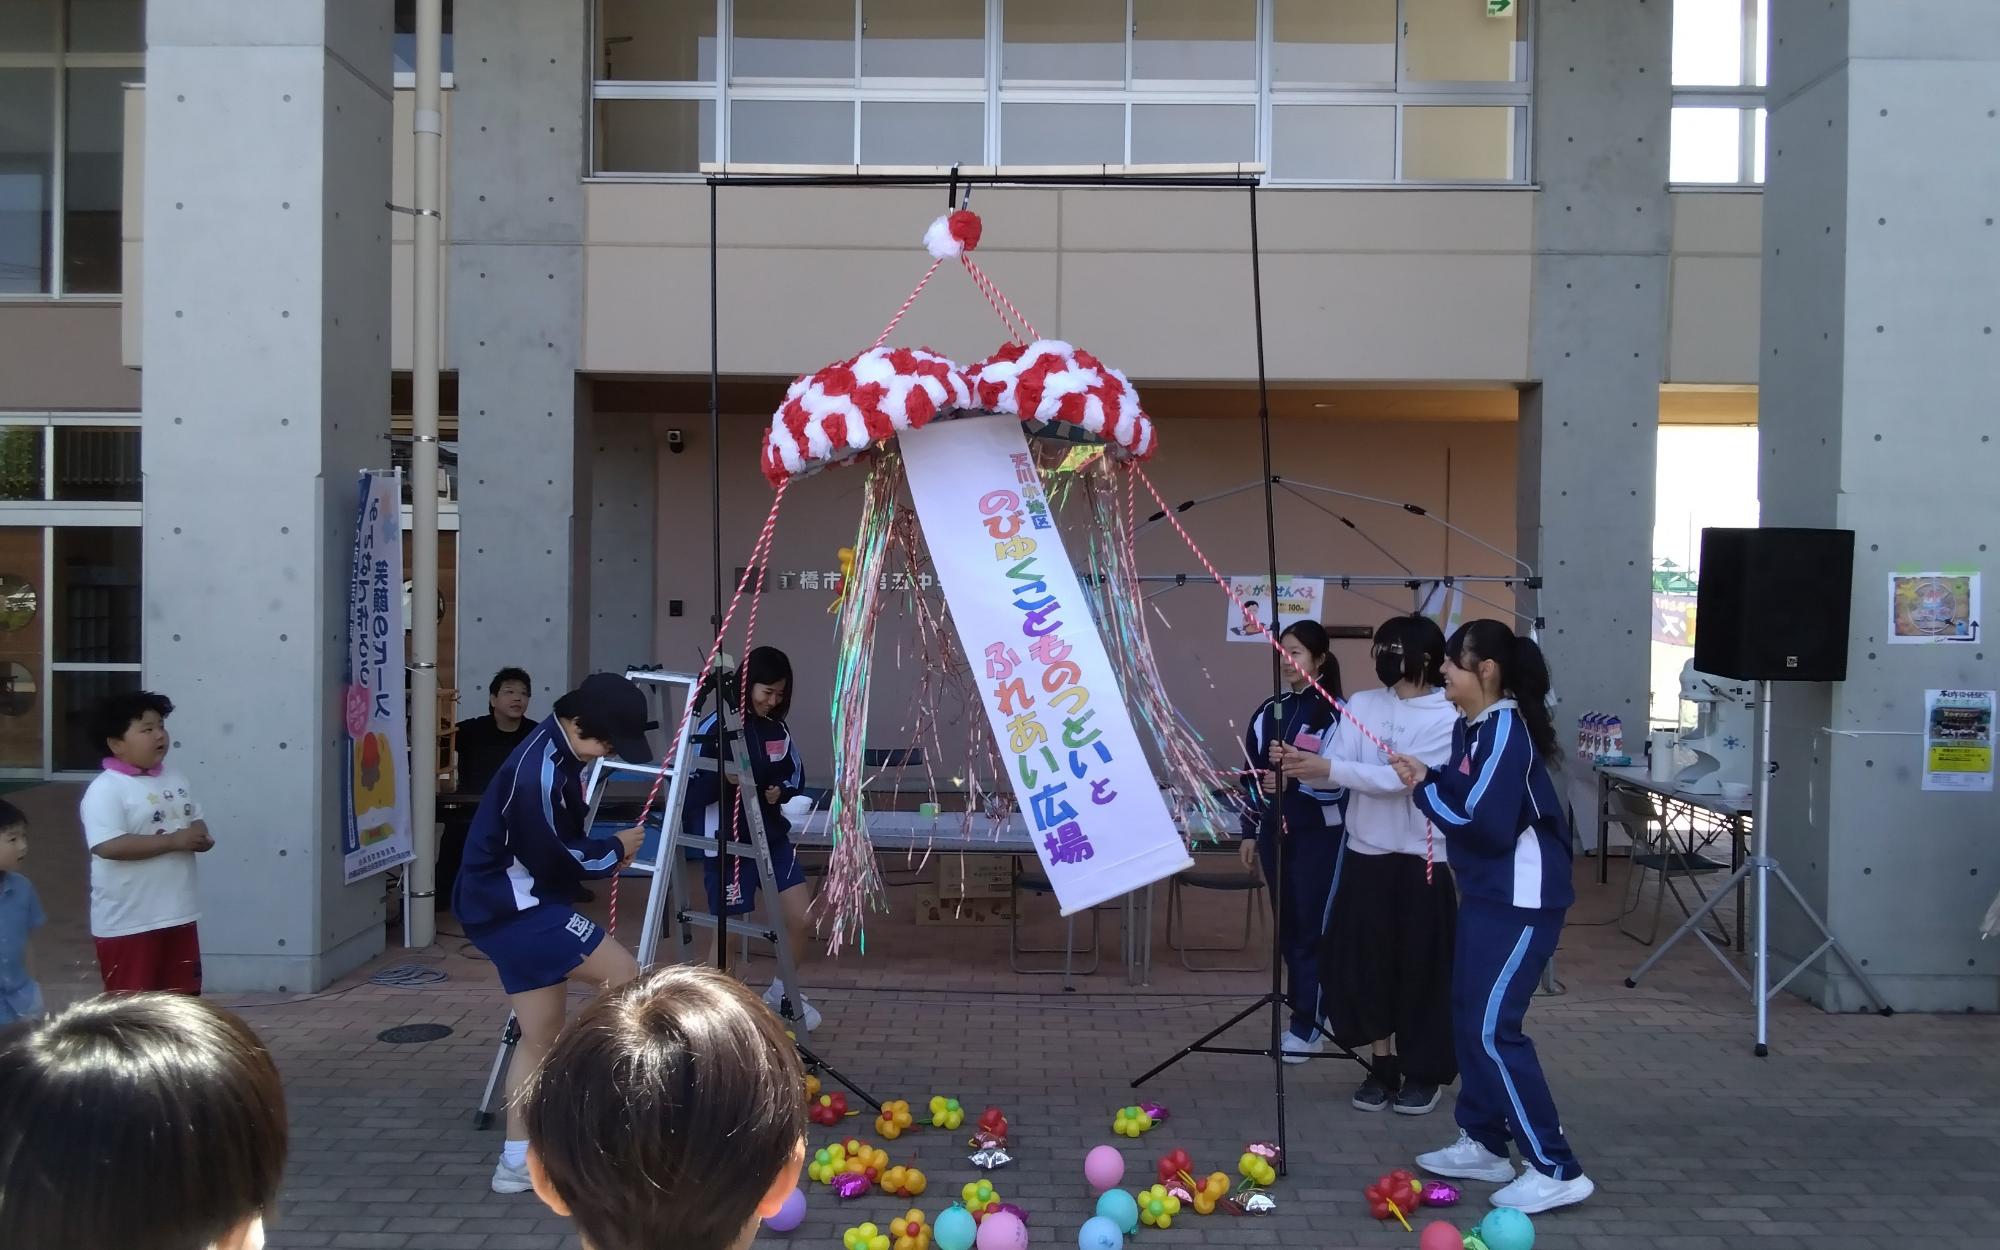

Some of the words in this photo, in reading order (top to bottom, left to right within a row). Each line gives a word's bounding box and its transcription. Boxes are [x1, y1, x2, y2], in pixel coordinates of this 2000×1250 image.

[984, 641, 1095, 867] ふれあい広場
